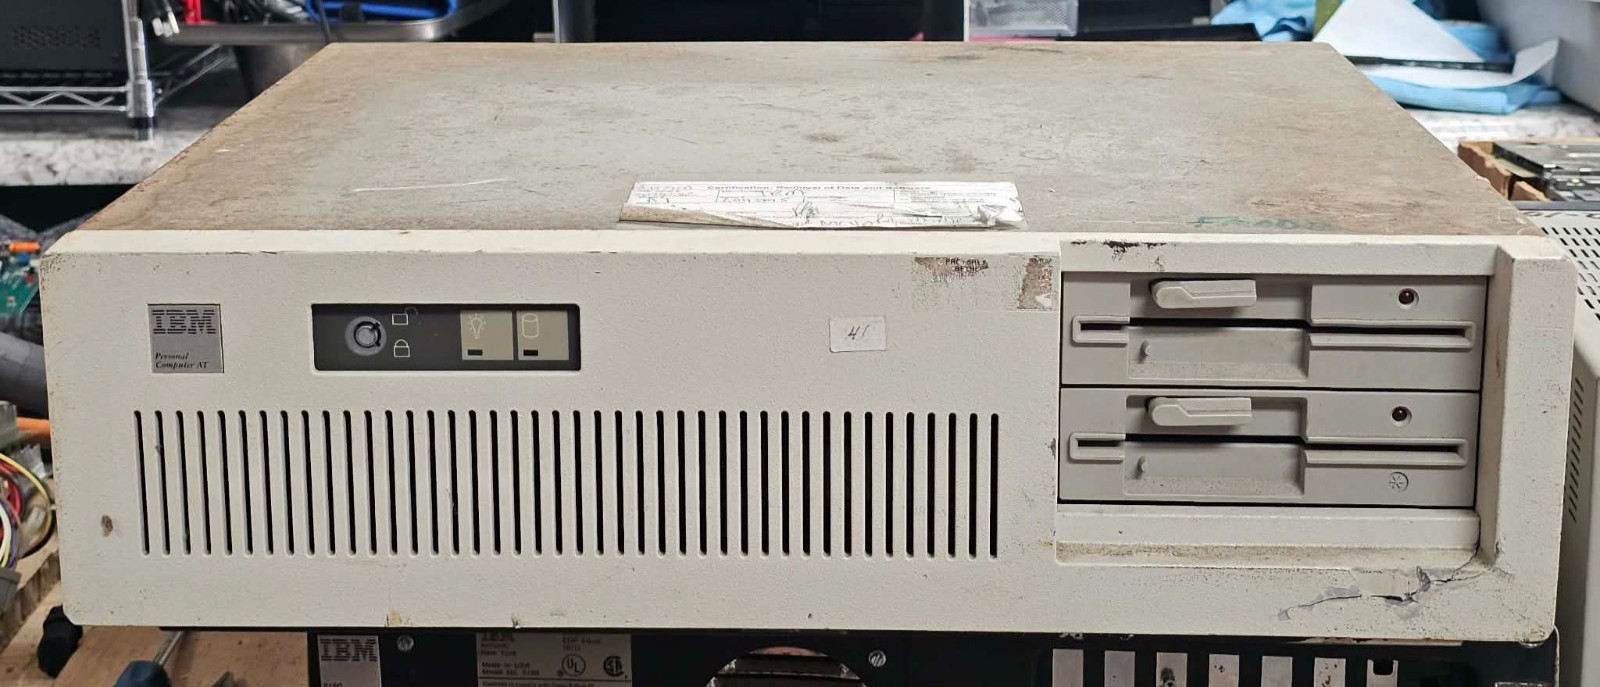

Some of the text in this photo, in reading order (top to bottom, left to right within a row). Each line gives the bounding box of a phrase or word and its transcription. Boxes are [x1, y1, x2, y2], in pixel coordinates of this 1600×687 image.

[152, 309, 217, 334] IBM
[155, 352, 189, 360] Personal
[155, 361, 208, 370] Computer AT
[320, 638, 378, 662] IBM
